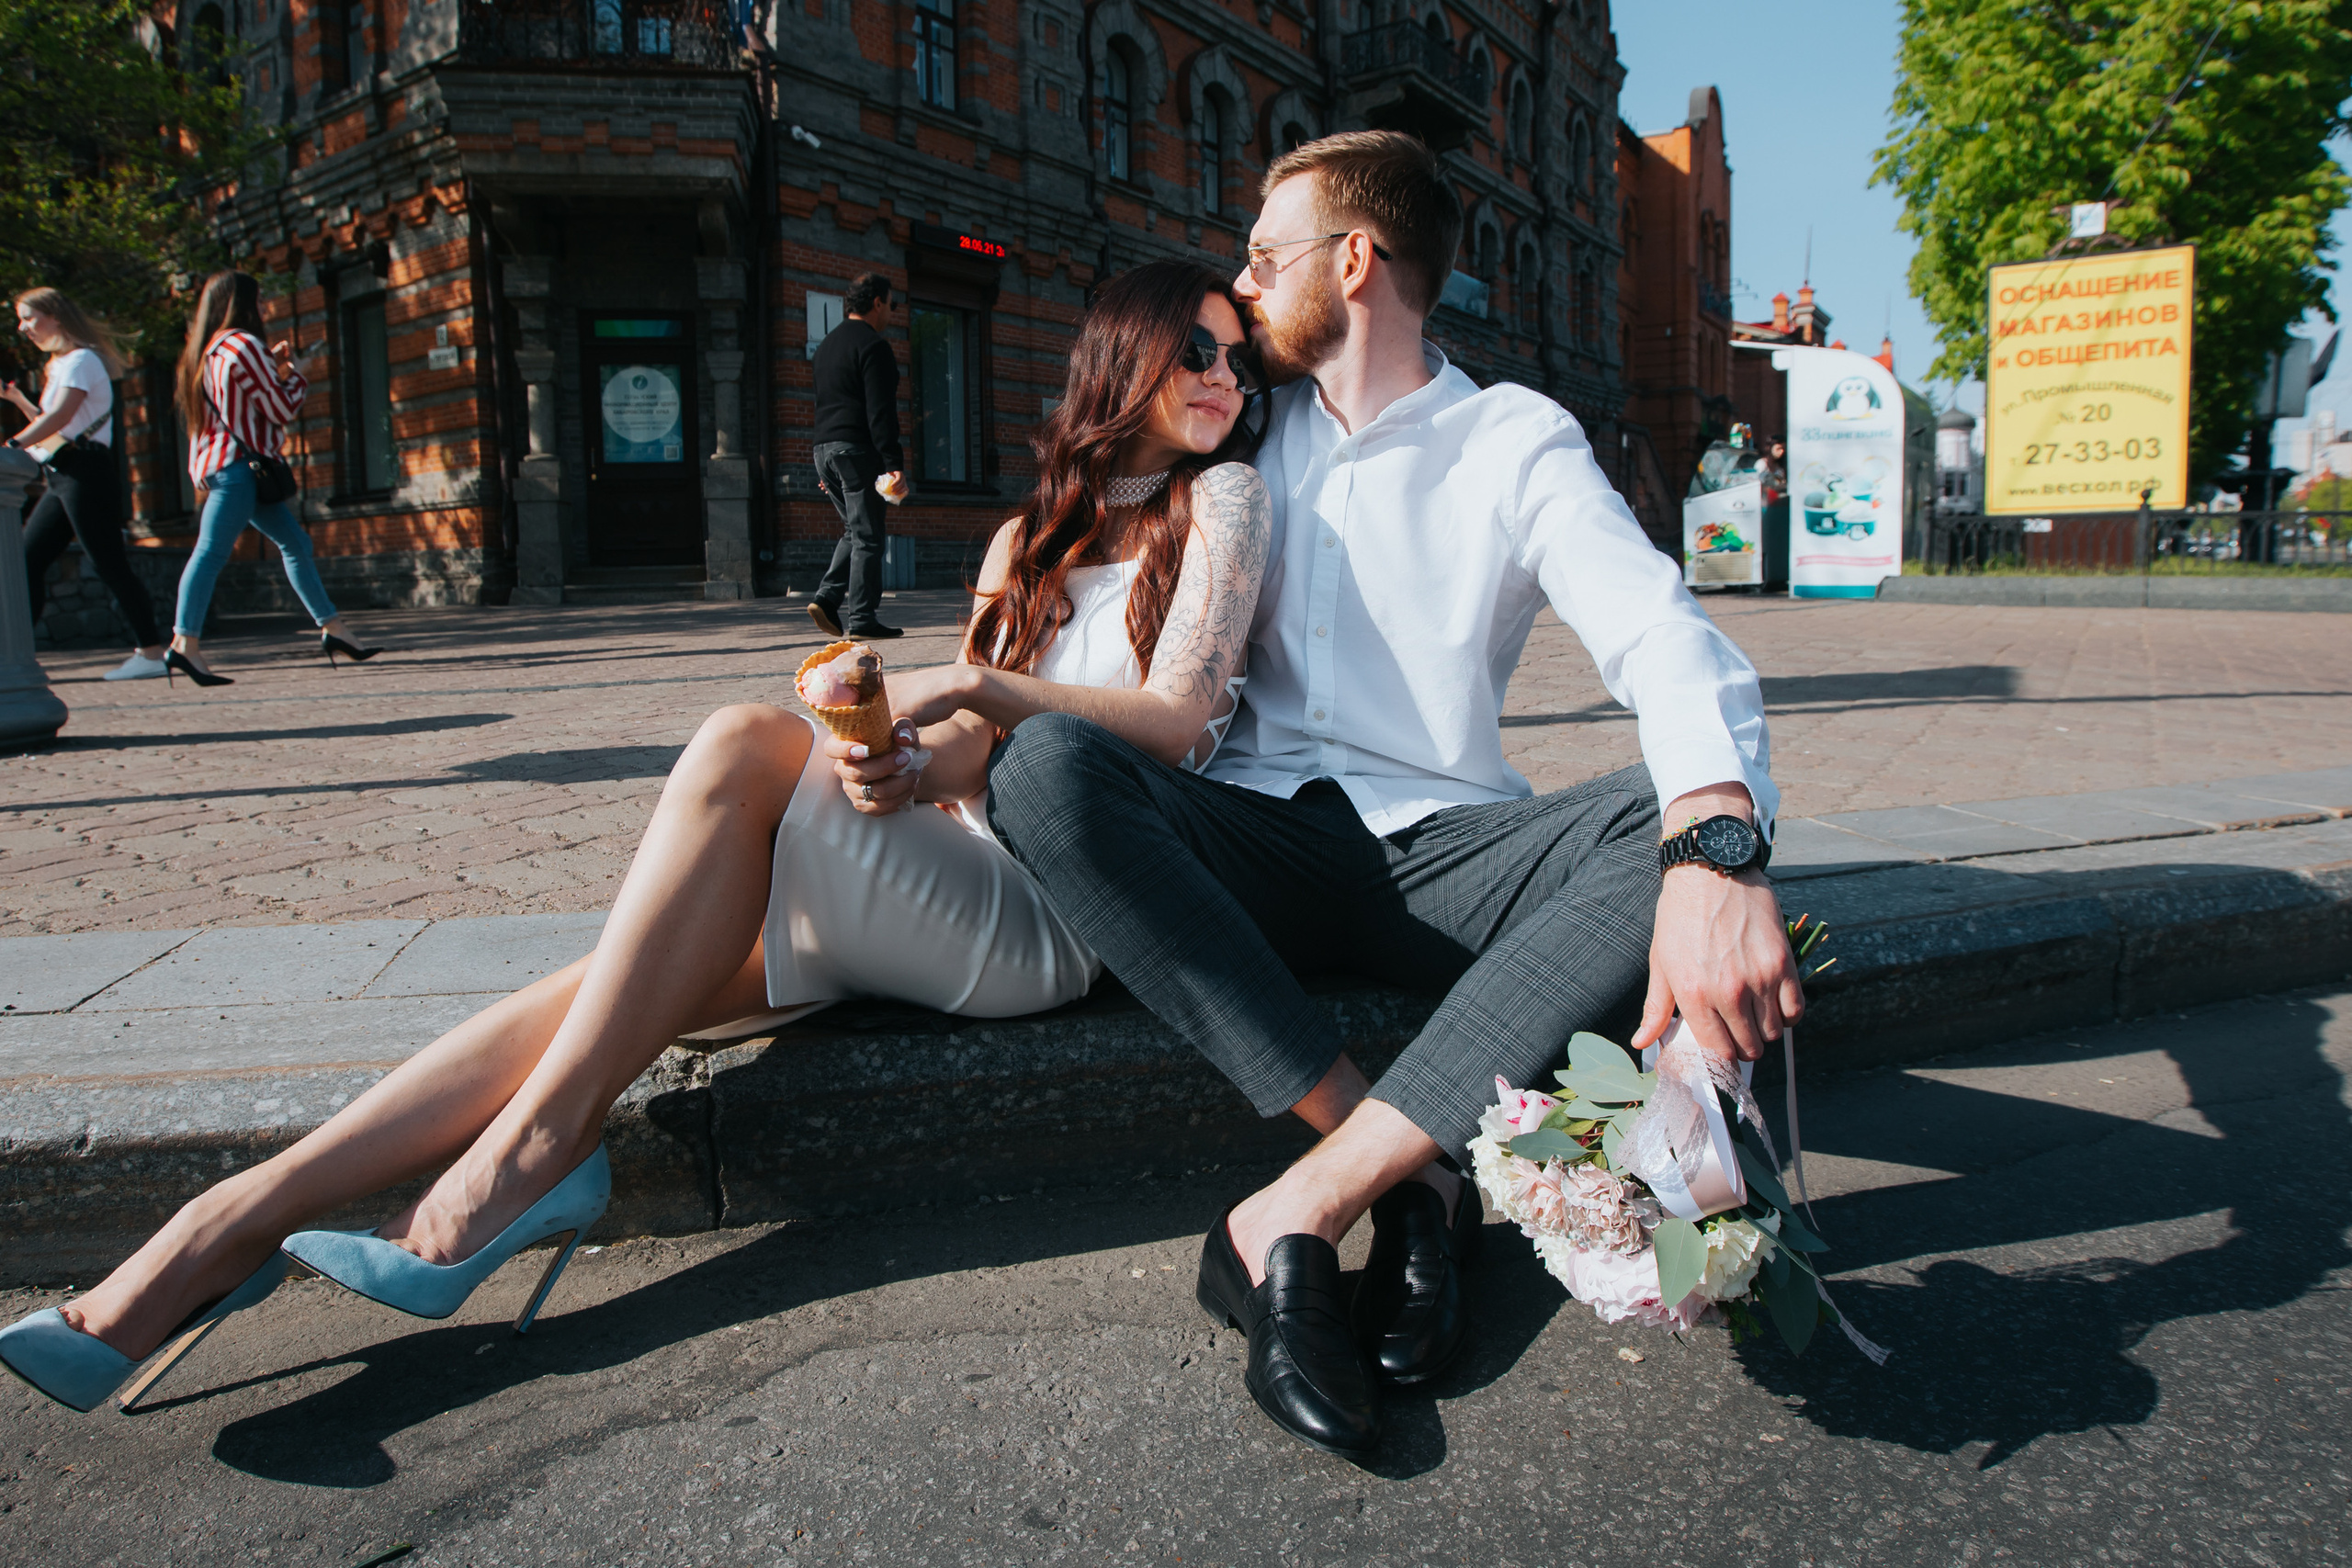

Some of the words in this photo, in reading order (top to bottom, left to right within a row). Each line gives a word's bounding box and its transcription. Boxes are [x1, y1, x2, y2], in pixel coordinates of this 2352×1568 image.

[1998, 269, 2180, 305] ОСНАЩЕНИЕ
[1998, 304, 2179, 337] МАГАЗИНОВ
[2016, 337, 2178, 367] ОБЩЕПИТА
[2021, 380, 2175, 405] Промышленная
[2081, 403, 2111, 423] 20
[2025, 436, 2161, 465] 27-33-03
